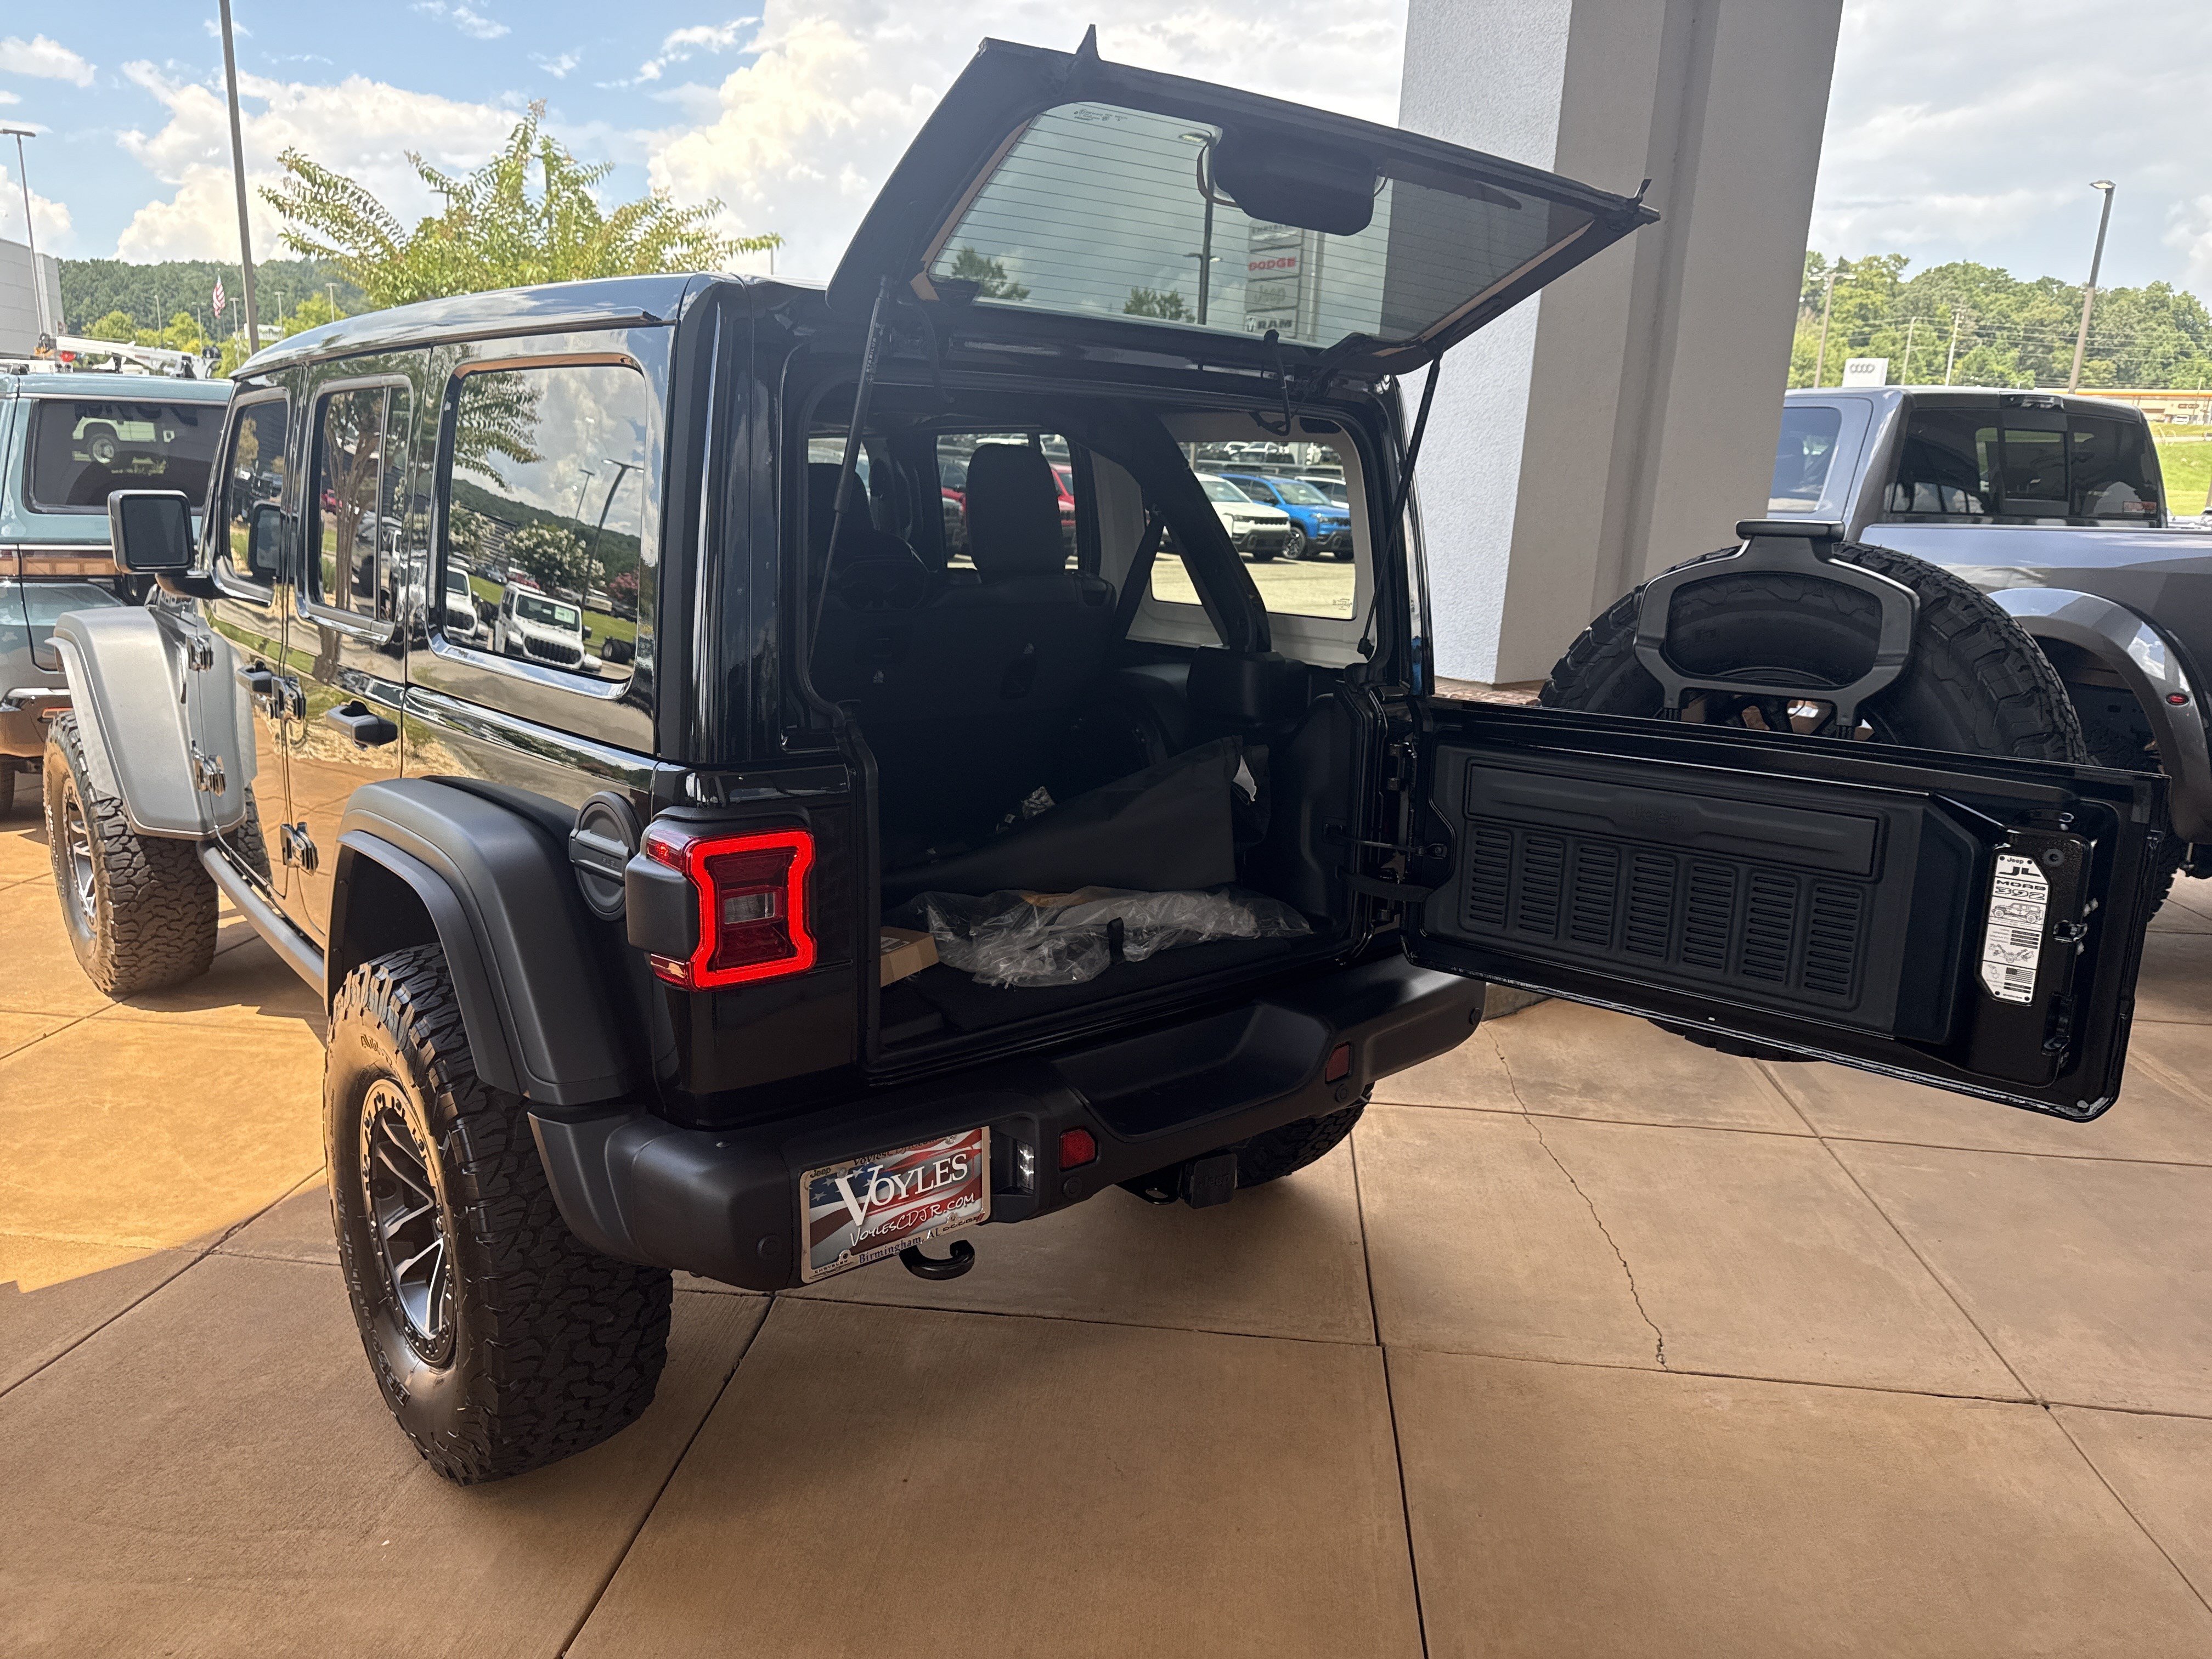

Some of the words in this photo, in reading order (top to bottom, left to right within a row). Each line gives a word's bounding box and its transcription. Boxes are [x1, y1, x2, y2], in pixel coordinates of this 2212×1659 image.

[1248, 257, 1296, 272] DODGE
[1254, 285, 1286, 304] Jeep
[1258, 320, 1292, 329] RAM
[1998, 866, 2041, 877] JL
[1996, 880, 2046, 890] MOAB
[1995, 887, 2045, 900] 392
[810, 1167, 831, 1178] Jeep
[927, 1228, 941, 1240] AL
